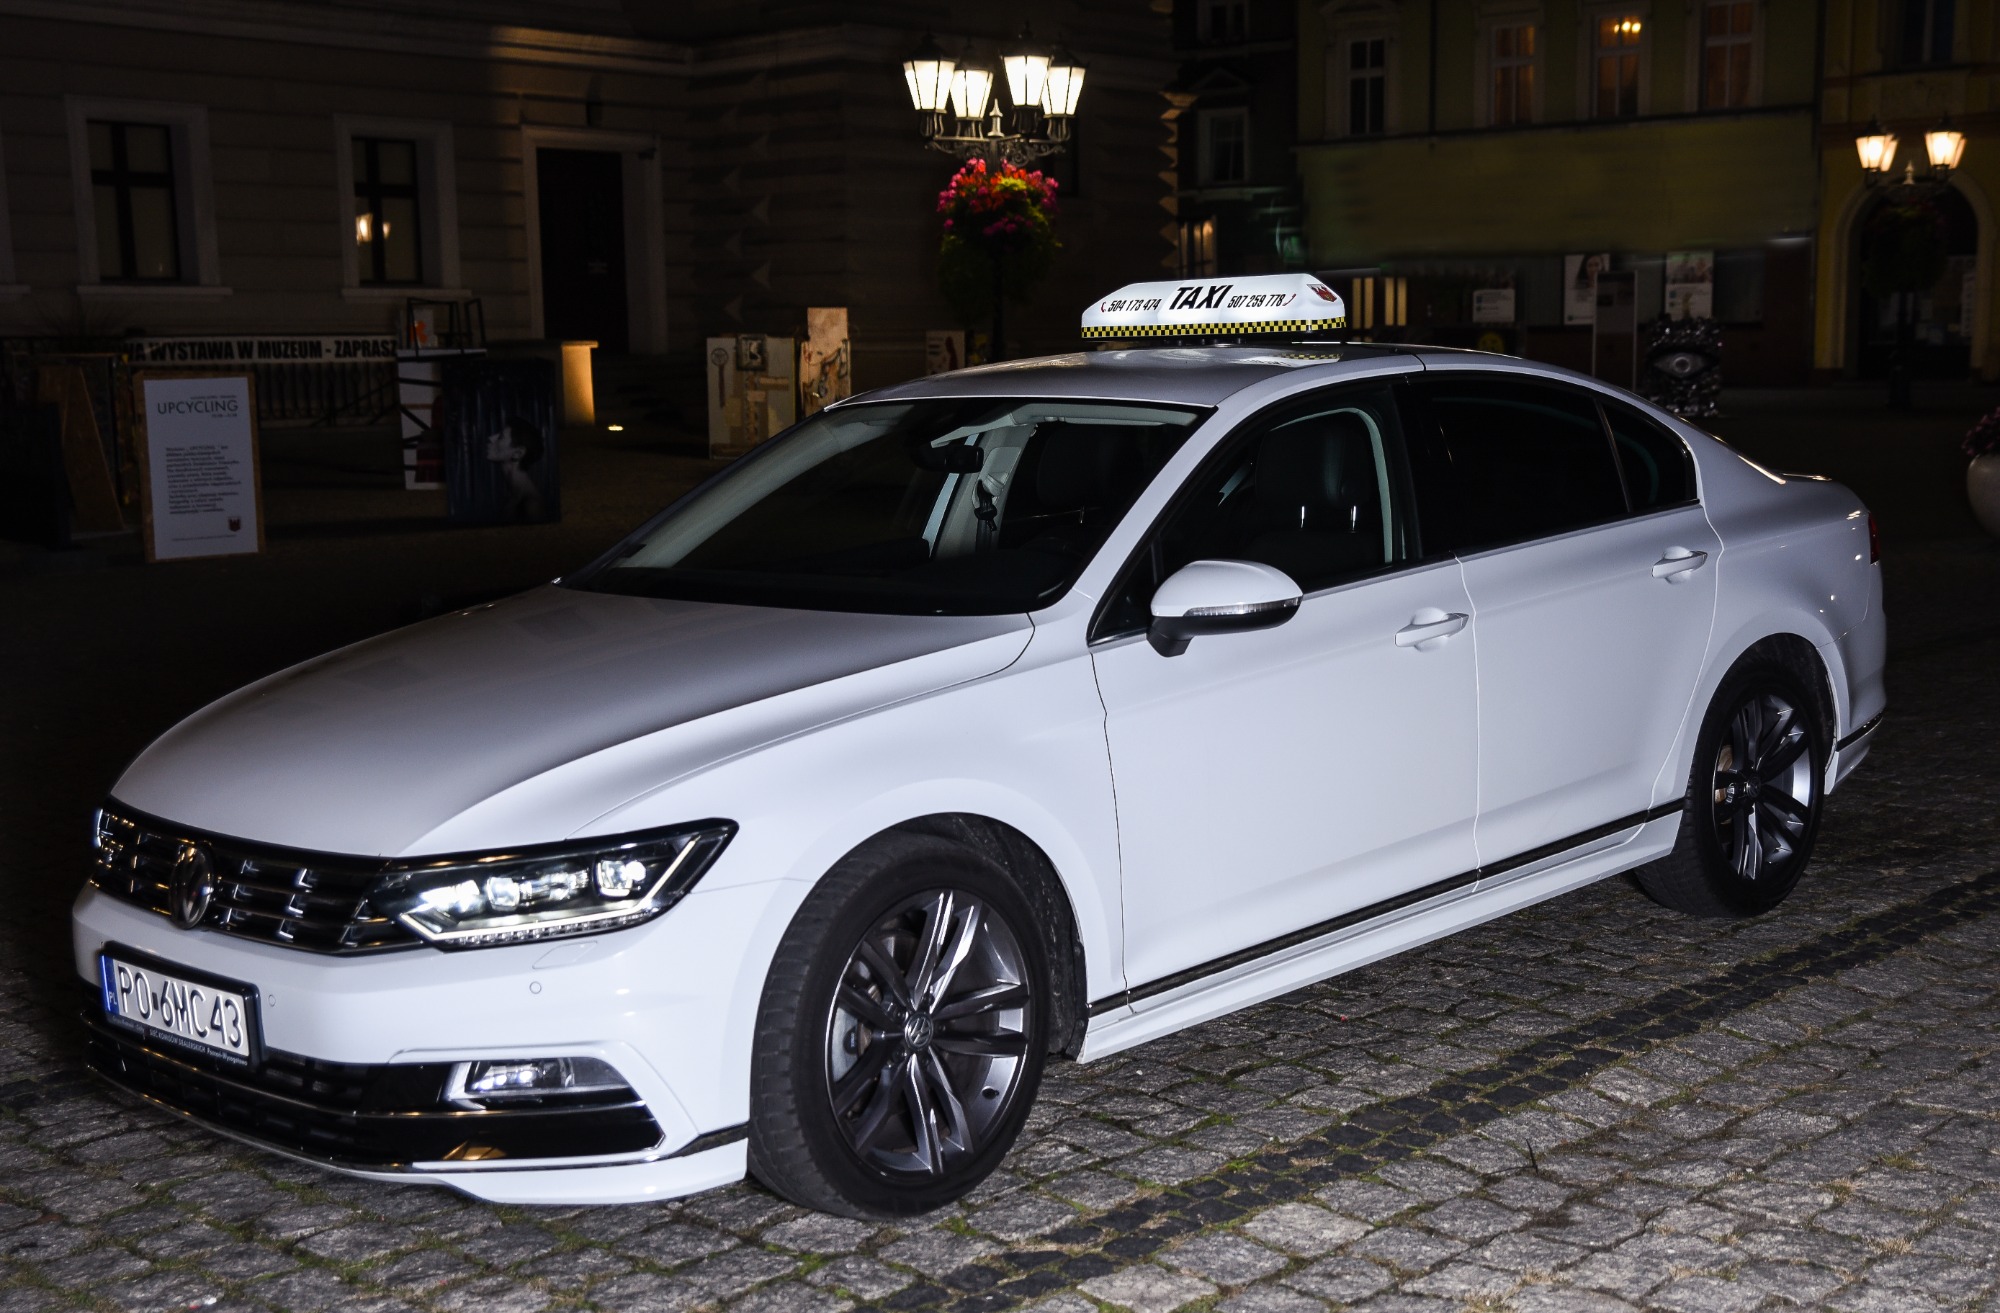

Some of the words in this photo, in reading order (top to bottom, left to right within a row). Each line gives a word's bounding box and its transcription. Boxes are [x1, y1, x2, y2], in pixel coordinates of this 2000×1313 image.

[1107, 298, 1126, 312] 504
[1126, 298, 1143, 311] 173
[1143, 298, 1162, 311] 474
[1169, 285, 1234, 310] TAXI
[1227, 295, 1246, 308] 507
[1246, 294, 1264, 307] 259
[1265, 293, 1285, 307] 778
[148, 340, 235, 361] WYSTAWA
[237, 341, 254, 360] W
[257, 340, 322, 359] MUZEUM
[157, 401, 239, 414] UPCYCLING
[109, 991, 118, 1005] PL
